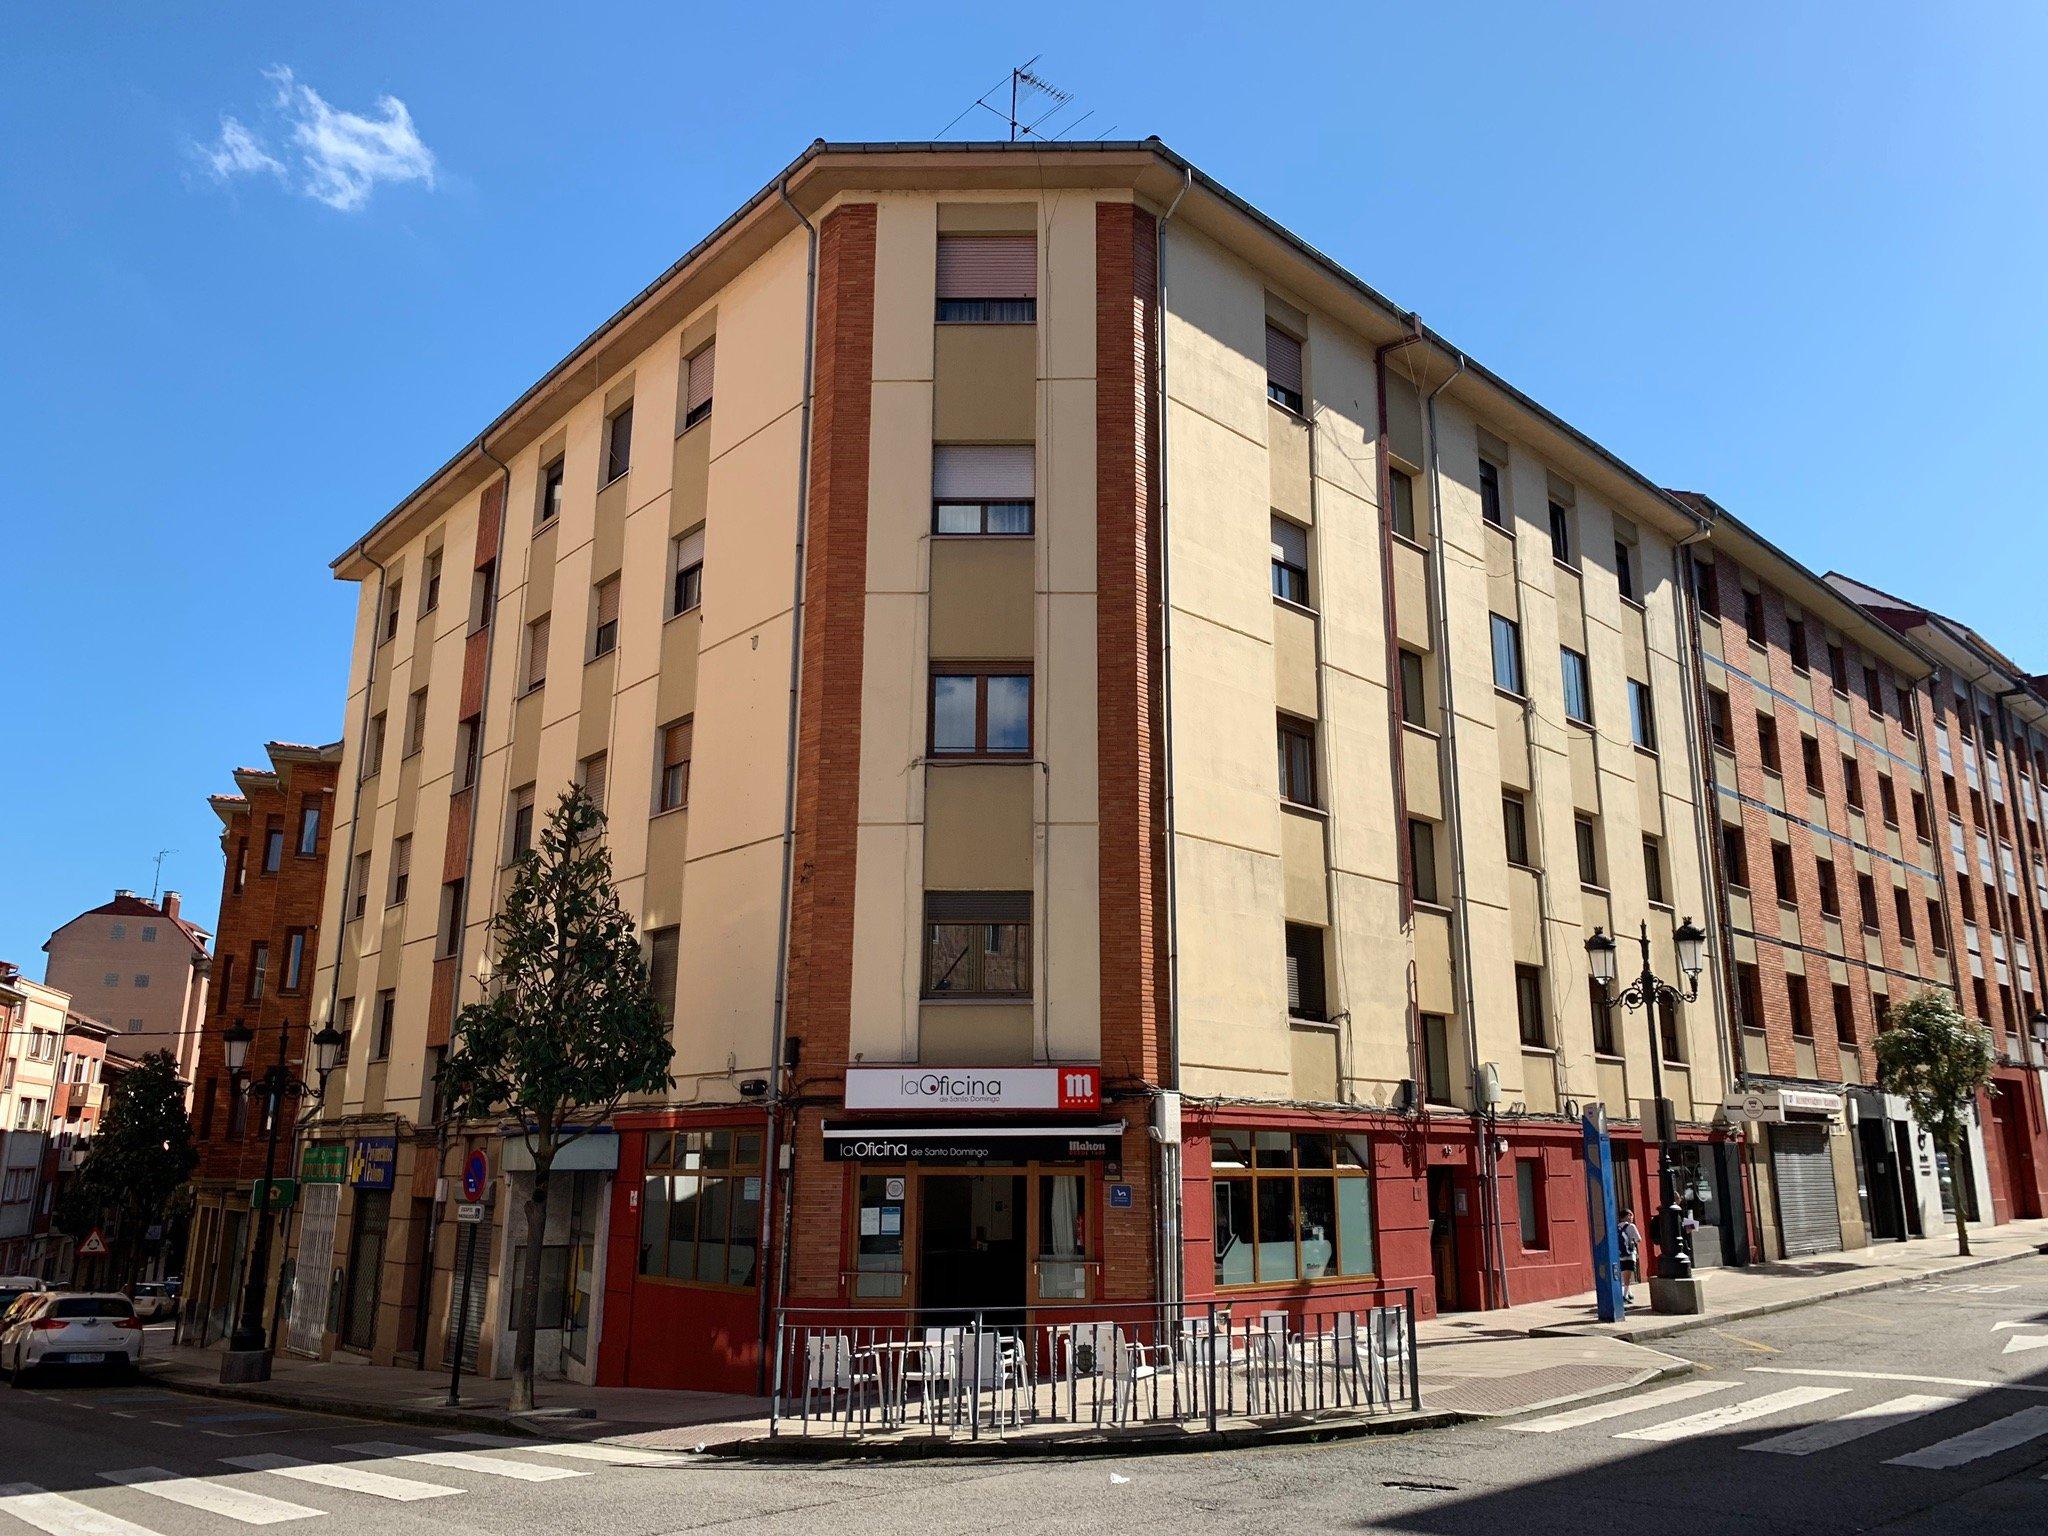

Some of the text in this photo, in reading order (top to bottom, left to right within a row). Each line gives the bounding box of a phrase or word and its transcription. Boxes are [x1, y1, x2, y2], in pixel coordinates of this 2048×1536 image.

[971, 1095, 1001, 1103] Domingo
[1069, 1140, 1106, 1151] Mahou
[911, 1148, 923, 1156] de
[925, 1147, 949, 1156] Santo
[950, 1147, 989, 1158] Domingo
